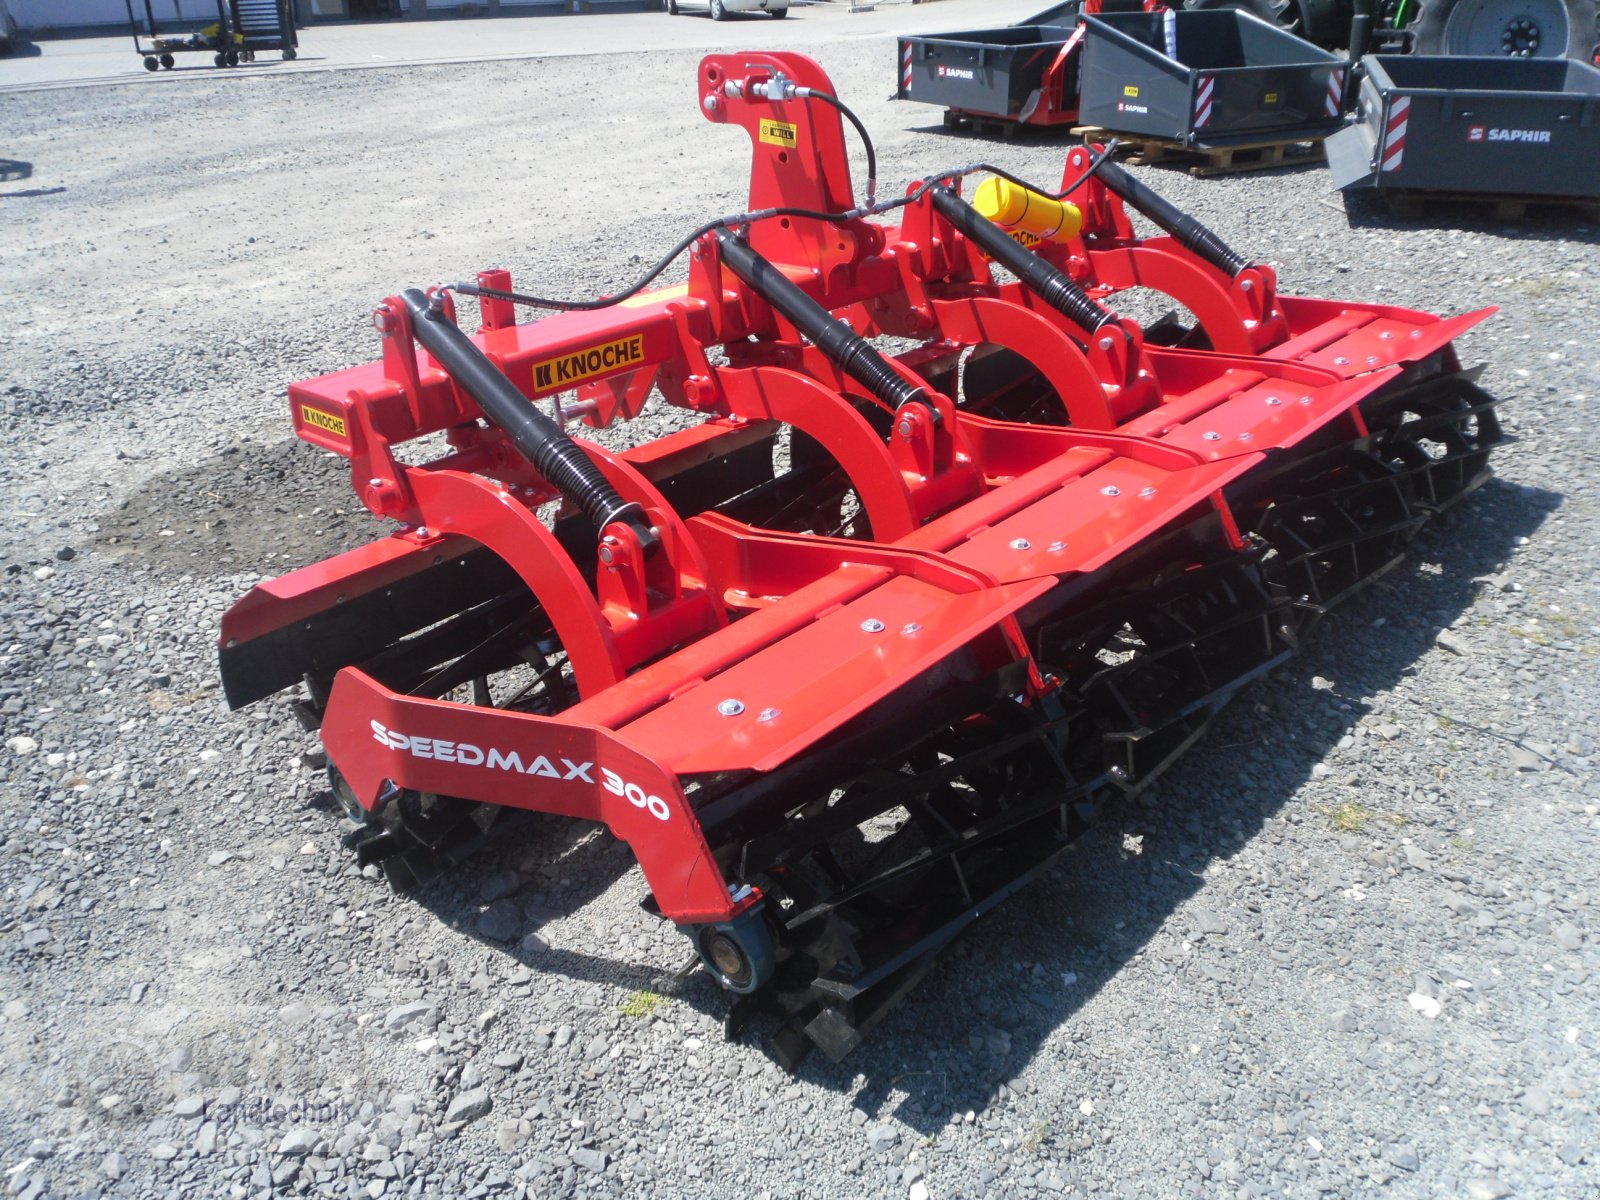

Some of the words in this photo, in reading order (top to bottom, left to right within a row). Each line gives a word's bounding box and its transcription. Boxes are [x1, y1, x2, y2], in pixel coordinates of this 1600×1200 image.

[946, 68, 973, 79] SAPHIR
[1125, 104, 1148, 113] SAPHIR
[773, 128, 791, 138] WILL
[1487, 128, 1551, 142] SAPHIR
[556, 338, 641, 381] KNOCHE
[310, 410, 344, 434] KNOCHE
[370, 719, 595, 784] SPEEDMAX
[601, 766, 670, 821] 300
